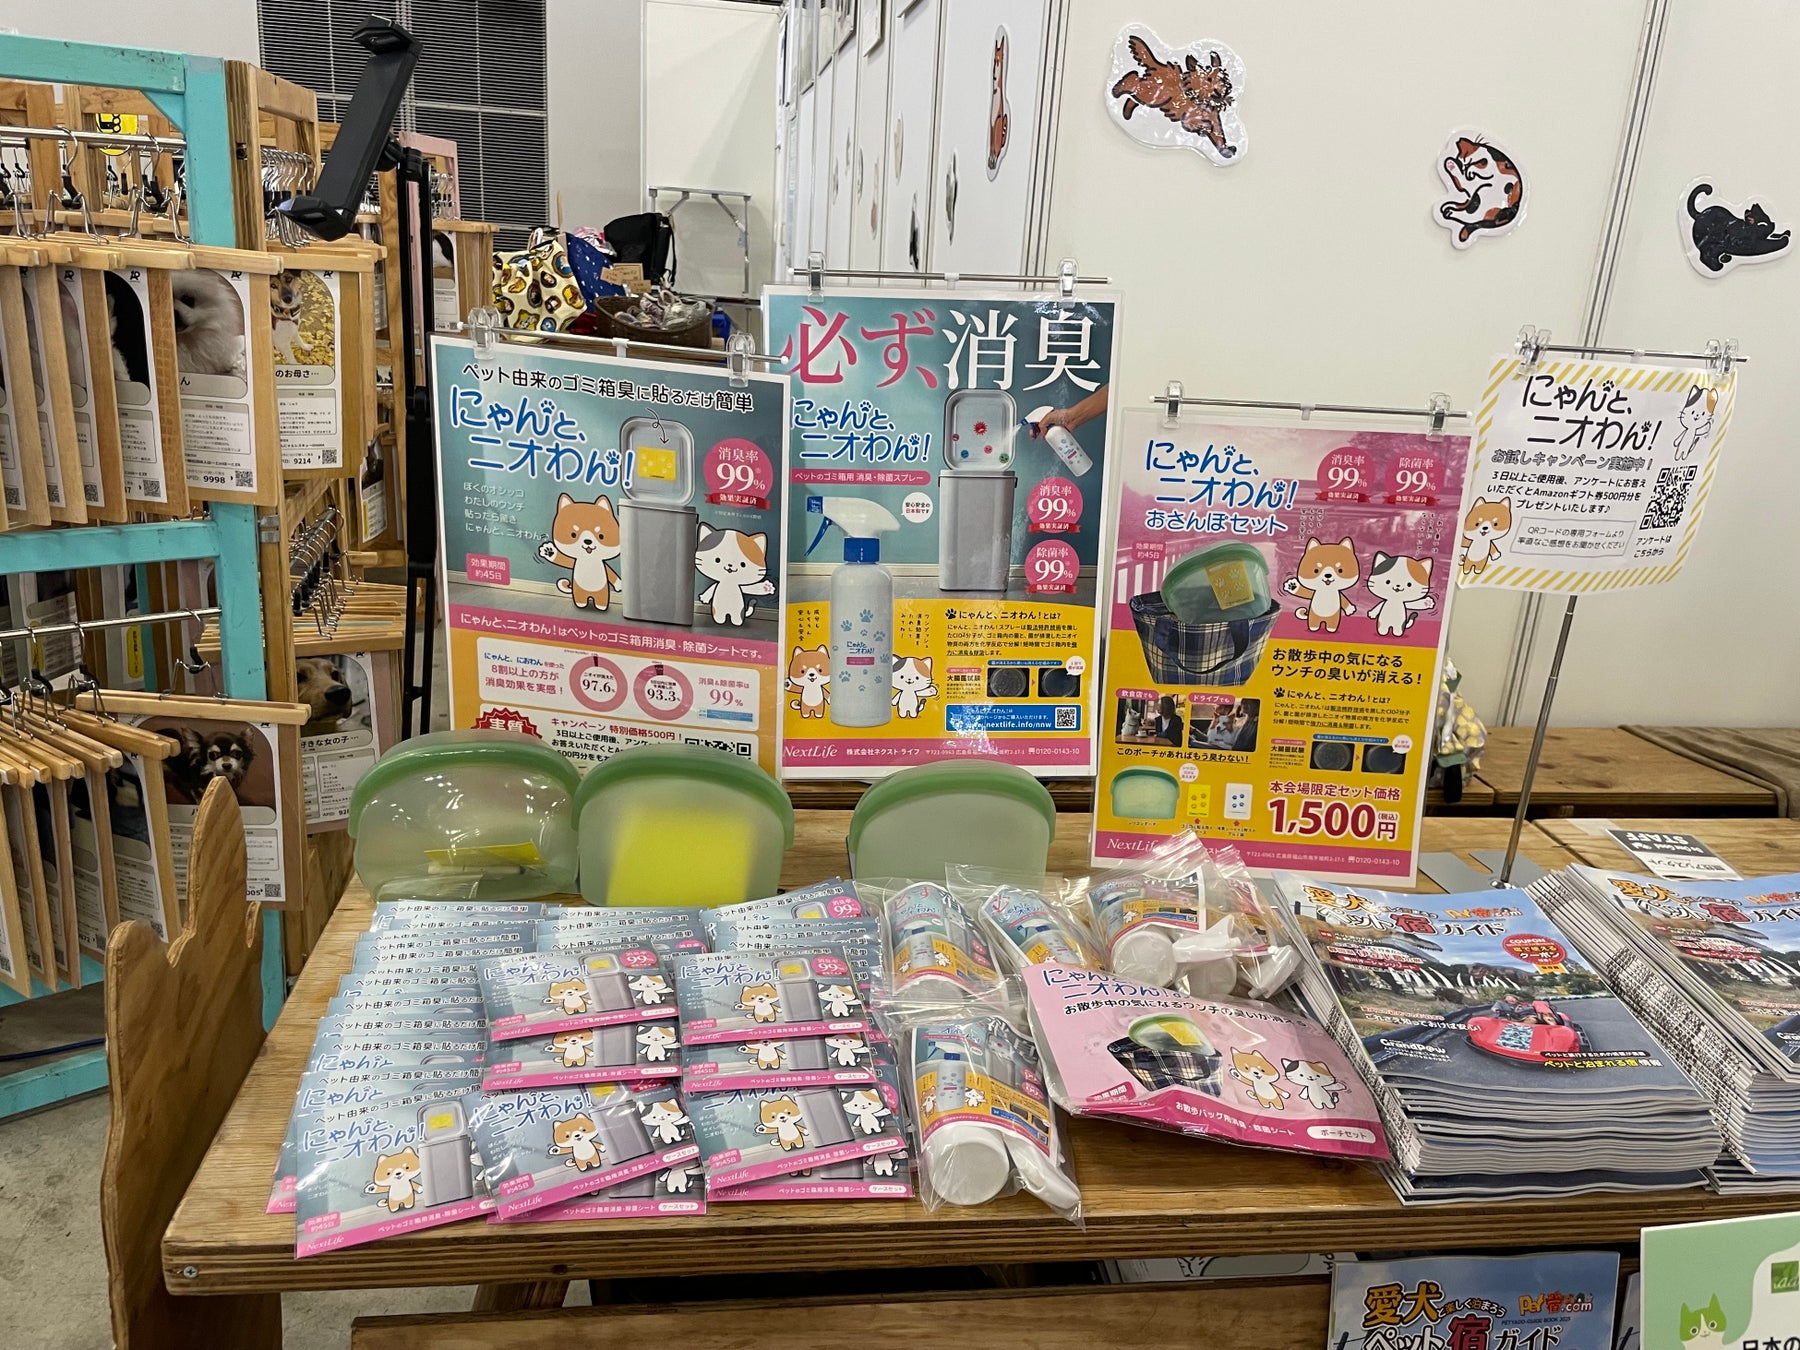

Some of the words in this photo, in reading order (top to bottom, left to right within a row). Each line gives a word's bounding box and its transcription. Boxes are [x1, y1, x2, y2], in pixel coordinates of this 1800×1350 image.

[780, 305, 1101, 392] 必ず、消臭
[463, 363, 753, 412] ペット由来のゴミ箱臭に貼るだけ簡単
[1527, 415, 1663, 451] ニオわん!
[719, 447, 759, 464] 消臭率
[799, 432, 932, 463] ニオわん!
[470, 434, 634, 488] ニオわん!
[203, 475, 226, 484] 9998
[716, 462, 767, 492] 99%
[1327, 467, 1368, 491] 99%
[1395, 470, 1437, 494] 99%
[1155, 476, 1299, 511] ニオわん!
[1038, 497, 1077, 521] 99%
[1146, 509, 1288, 534] おさんぽセット
[1034, 559, 1073, 583] 99%
[1271, 647, 1404, 668] お散歩中の気になる
[1271, 663, 1423, 686] ウンチの臭いが消える!
[551, 717, 606, 731] キャンペーン
[783, 744, 839, 758] NextLife
[1269, 780, 1401, 802] 本会場限定セット価格
[1106, 838, 1160, 852] NextLif
[1362, 1280, 1445, 1329] 愛犬
